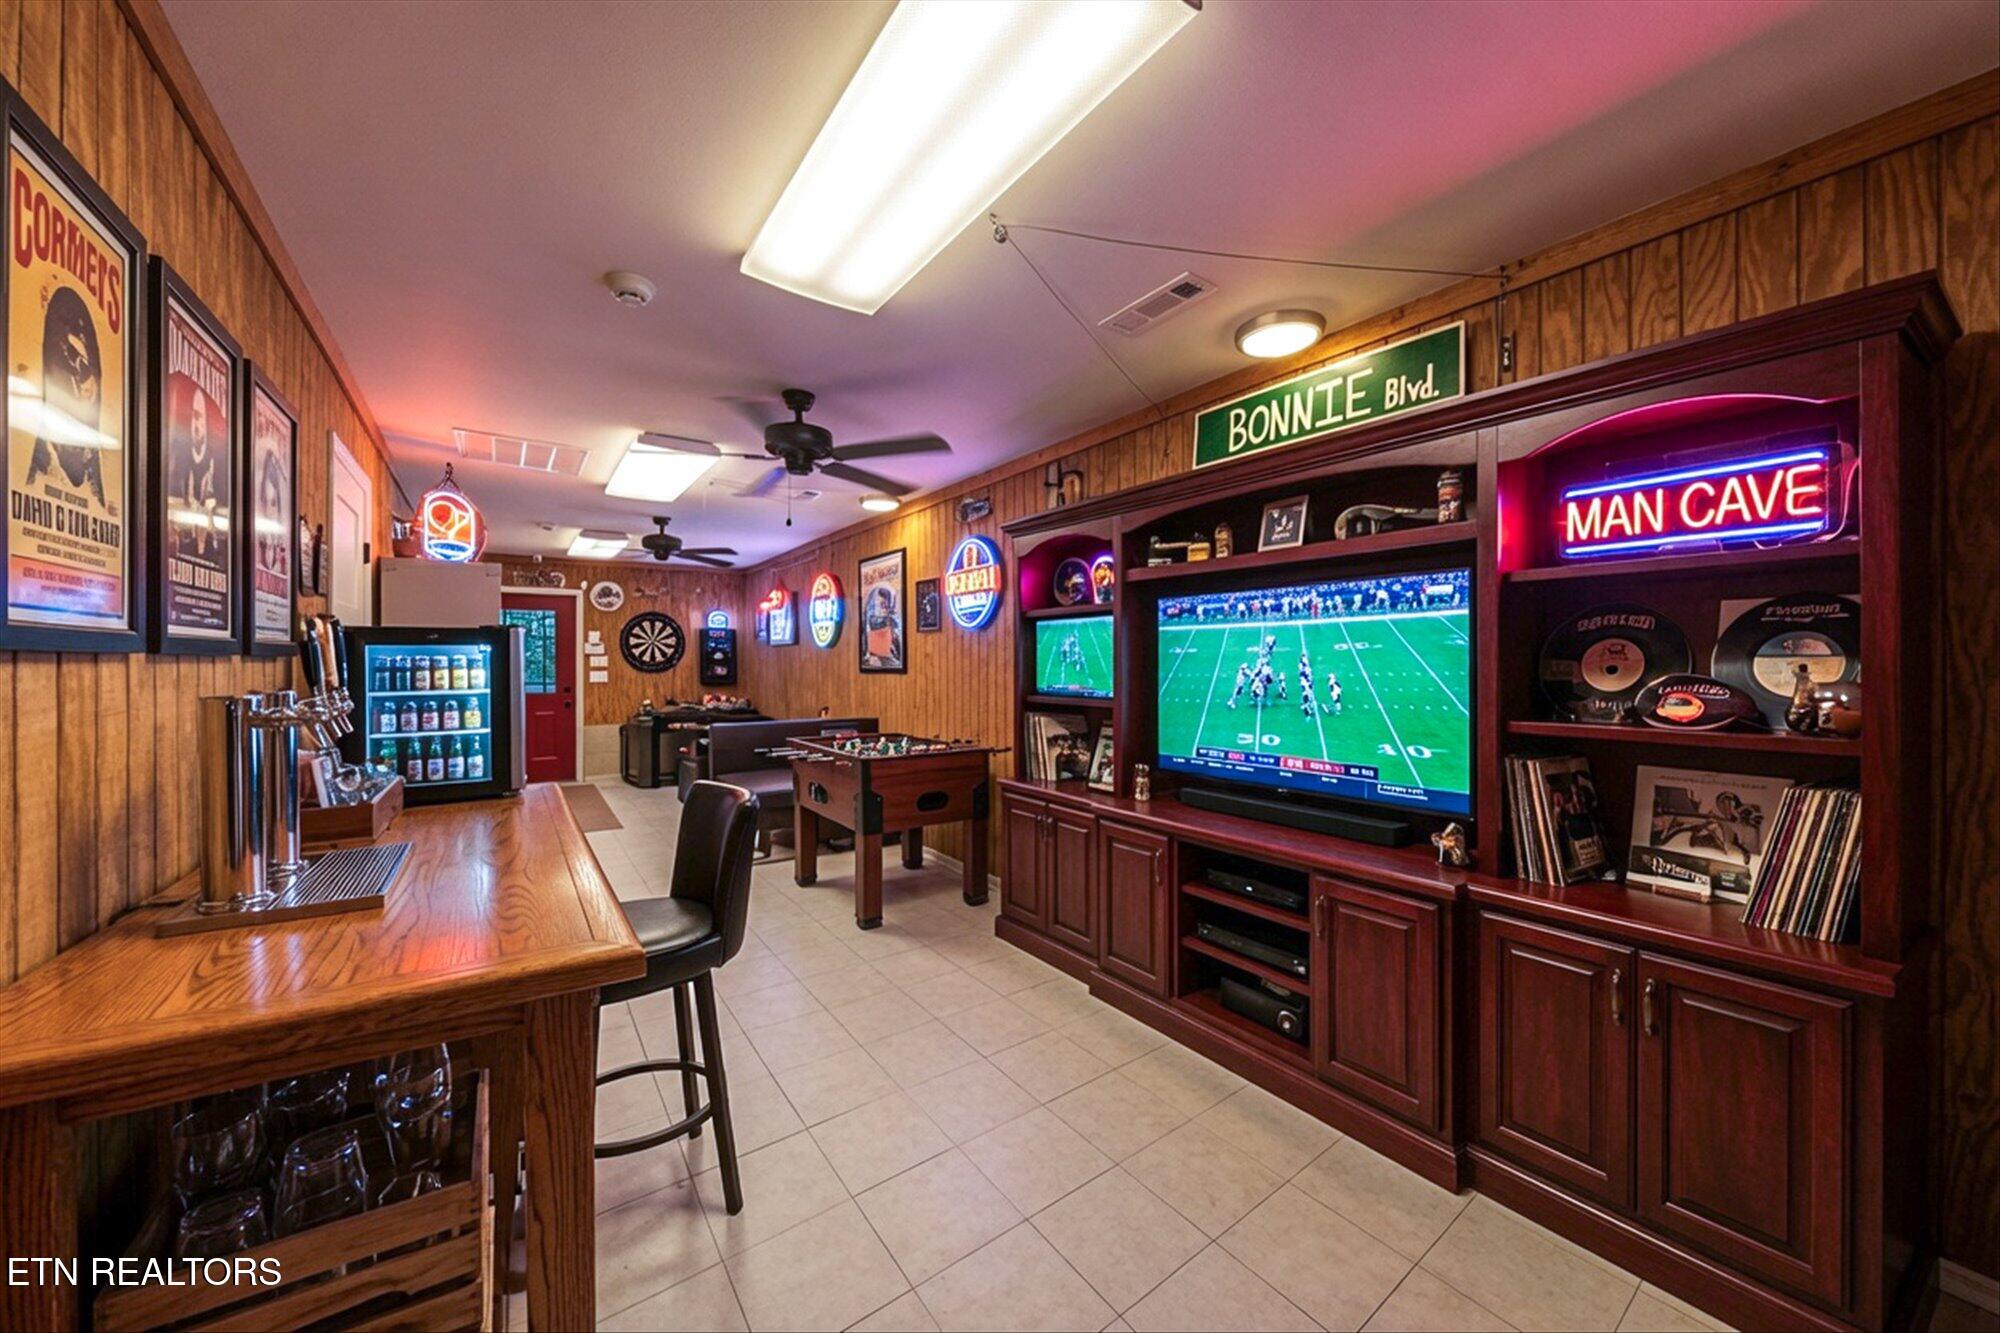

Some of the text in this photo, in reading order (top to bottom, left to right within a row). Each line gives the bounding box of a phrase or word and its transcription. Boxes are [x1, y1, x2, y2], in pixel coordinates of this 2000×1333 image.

[1228, 362, 1440, 452] BONNIE Blvd.
[1566, 463, 1823, 542] MAN CAVE
